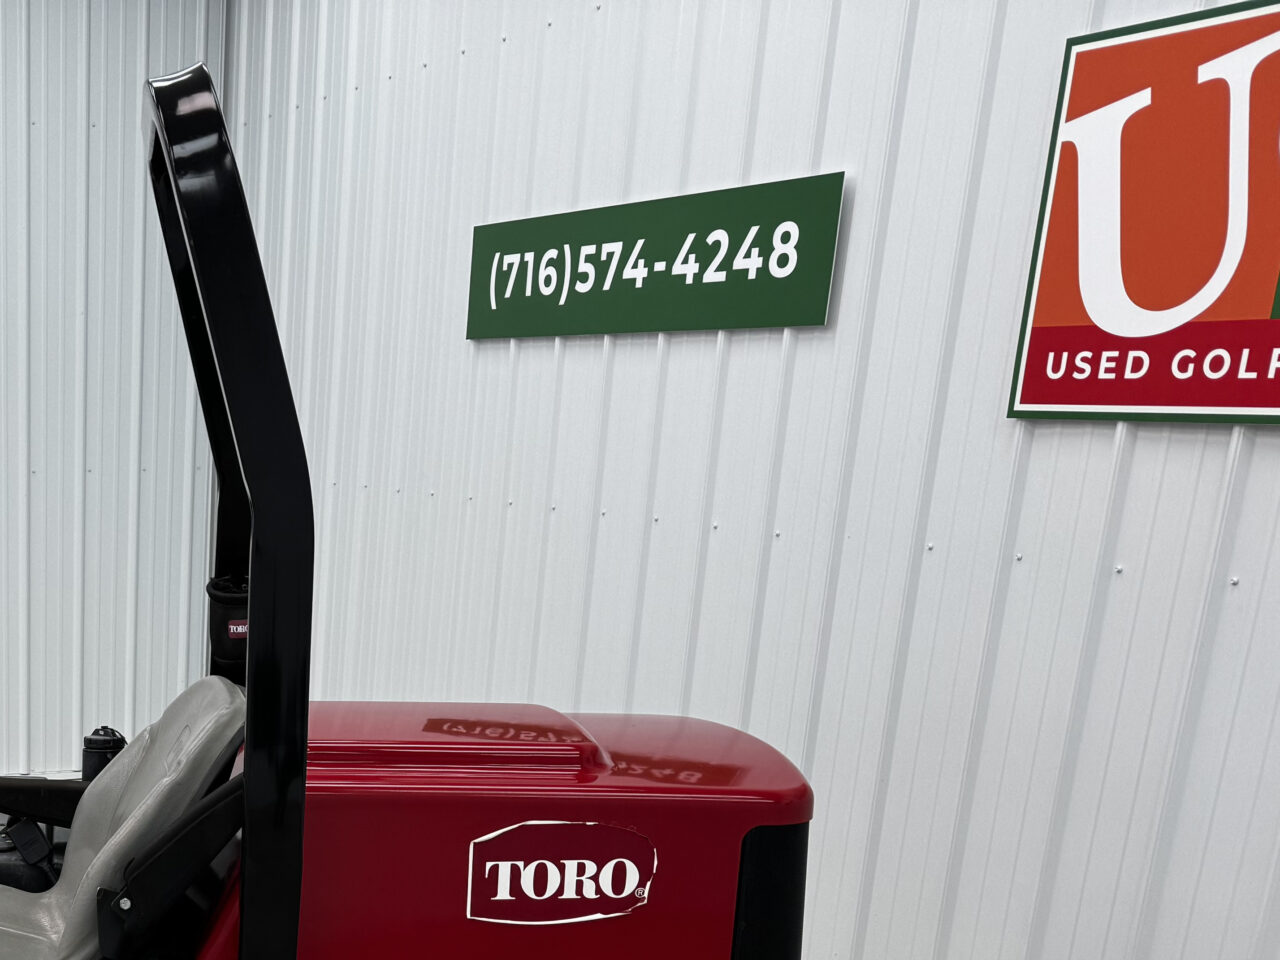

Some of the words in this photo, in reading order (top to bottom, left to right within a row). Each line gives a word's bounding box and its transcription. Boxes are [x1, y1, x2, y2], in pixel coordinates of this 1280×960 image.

[489, 220, 801, 310] (716)574-4248
[1046, 350, 1150, 380] USED
[485, 858, 640, 900] TORO
